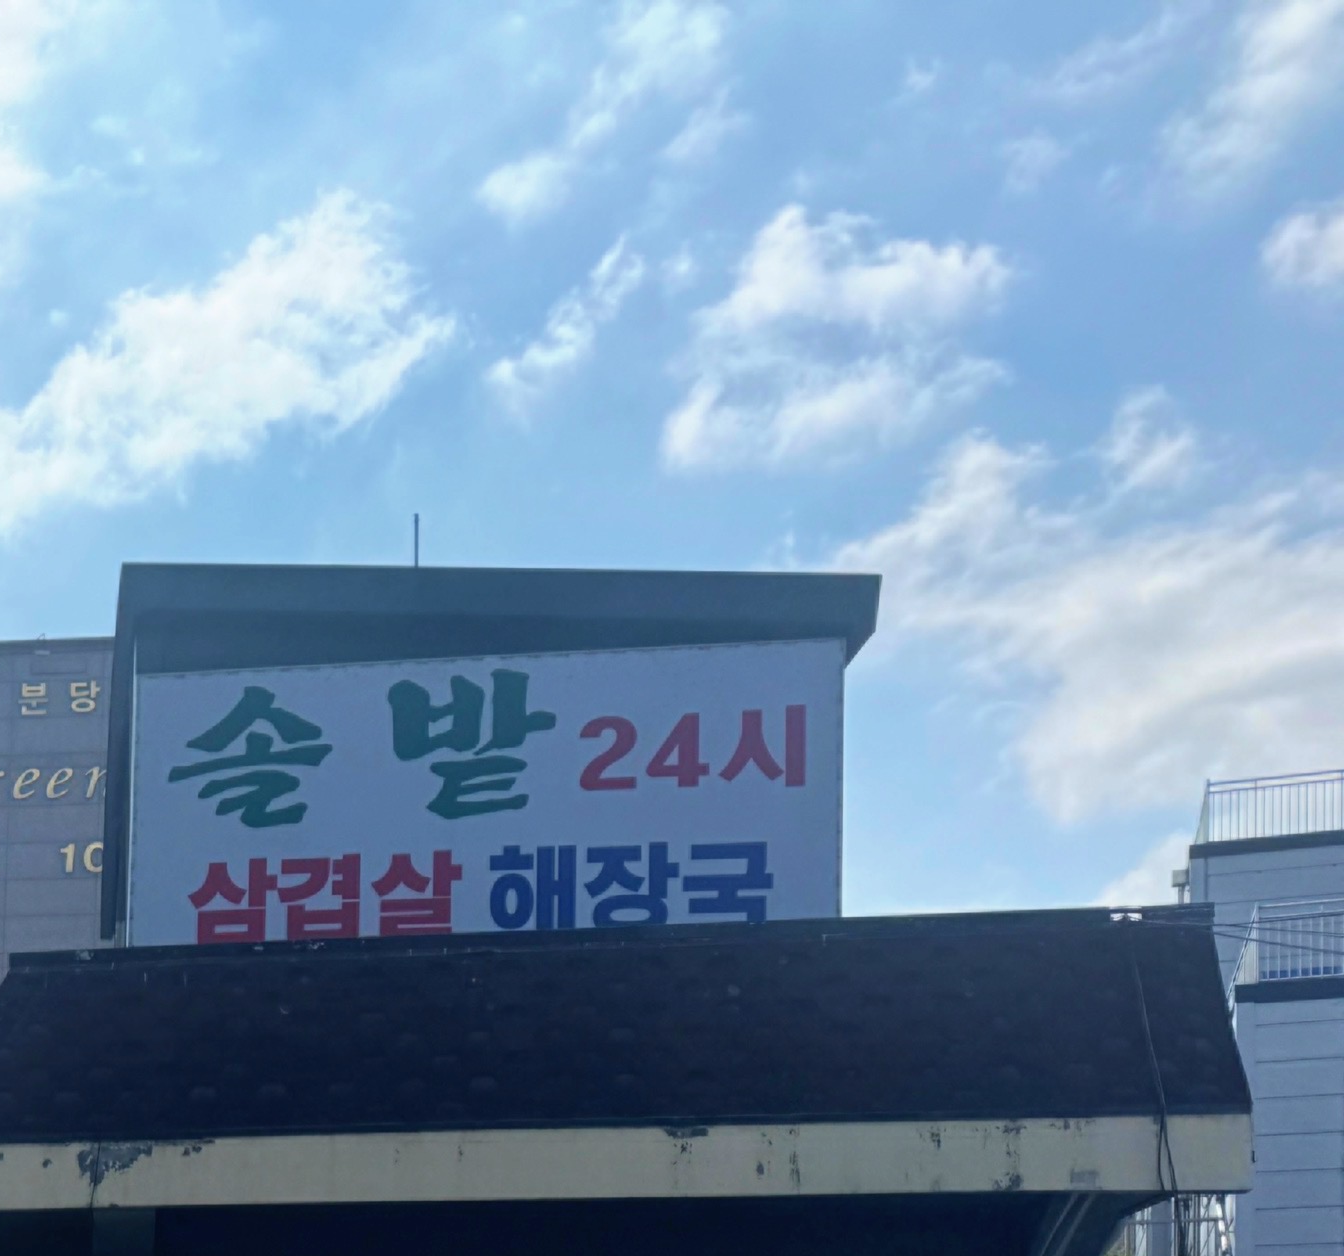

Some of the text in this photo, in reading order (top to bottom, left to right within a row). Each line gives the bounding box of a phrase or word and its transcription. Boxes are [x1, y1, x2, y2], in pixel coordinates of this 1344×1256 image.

[17, 680, 101, 716] 분당
[579, 704, 807, 791] 24시
[187, 841, 774, 945] 삼겹살 해장국
